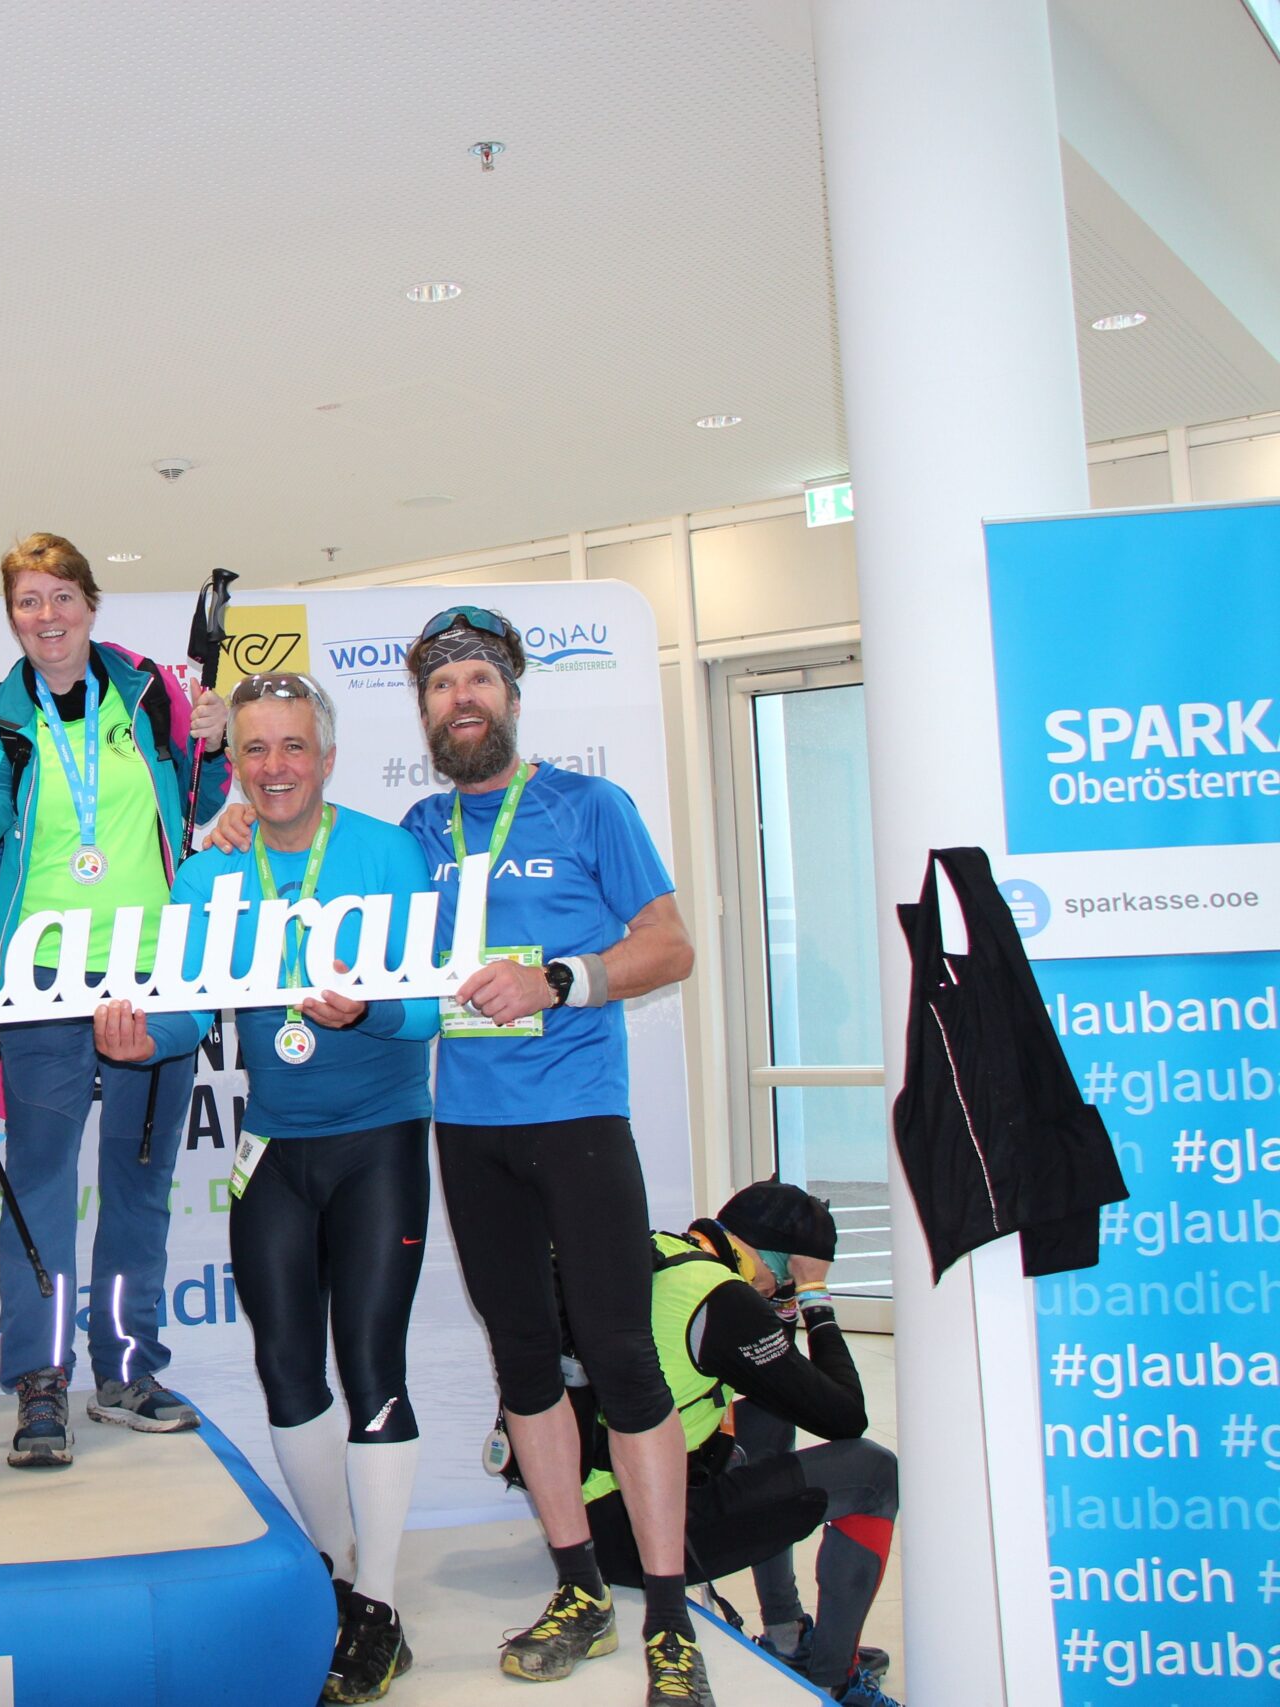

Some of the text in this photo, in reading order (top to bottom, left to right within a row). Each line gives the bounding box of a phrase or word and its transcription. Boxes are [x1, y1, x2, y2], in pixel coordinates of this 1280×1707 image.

[1044, 698, 1280, 764] SPARK
[494, 858, 553, 879] AG
[1064, 891, 1259, 918] sparkasse.ooe
